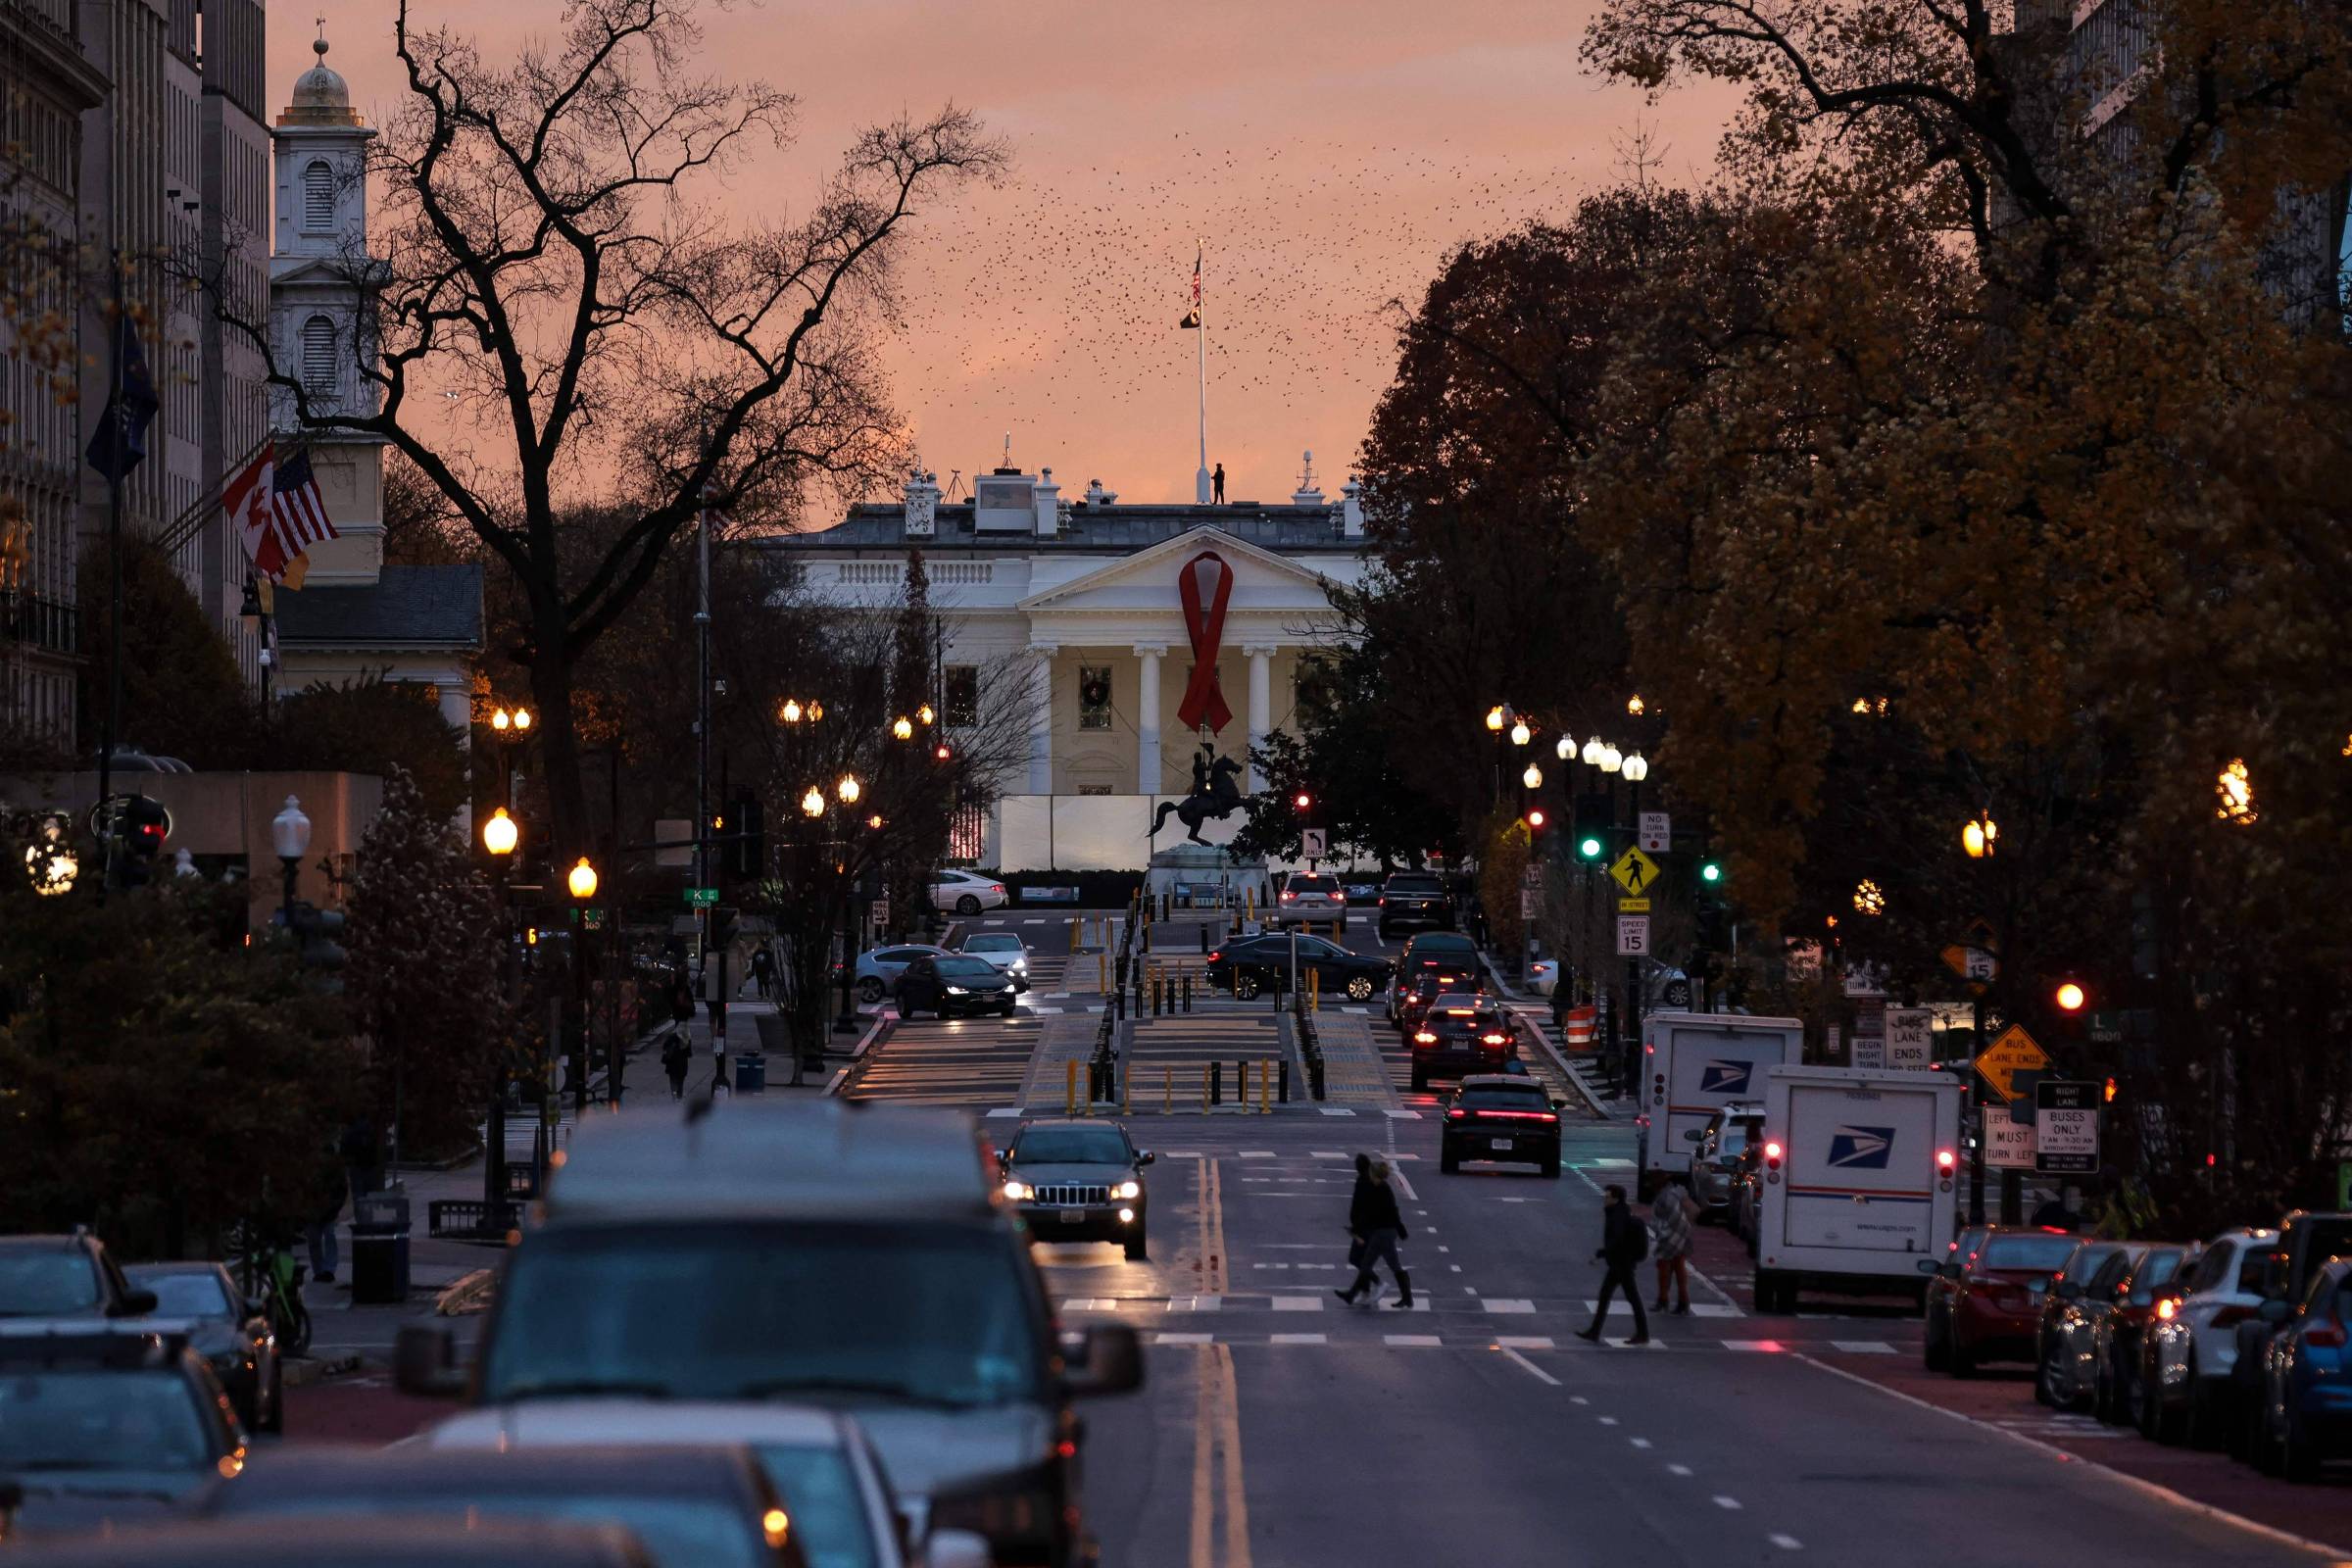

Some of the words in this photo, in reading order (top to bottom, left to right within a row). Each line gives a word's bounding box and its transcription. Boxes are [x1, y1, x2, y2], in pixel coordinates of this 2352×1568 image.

[1648, 814, 1662, 823] NO
[694, 890, 703, 901] K
[1624, 936, 1642, 951] 15
[1970, 964, 1990, 979] 15
[2094, 1013, 2105, 1028] L
[1894, 1032, 1922, 1044] LANE
[2006, 1040, 2027, 1049] BUS
[1857, 1051, 1882, 1059] RIGHT
[1894, 1049, 1923, 1059] ENDS
[1990, 1054, 2012, 1062] LANE
[2017, 1054, 2040, 1063] ENDS
[2056, 1087, 2080, 1097] RIGHT
[2057, 1098, 2079, 1106] LANE
[1988, 1114, 2009, 1124] LEFT
[2050, 1112, 2085, 1122] BUSES
[2053, 1124, 2082, 1135] ONLY
[1997, 1132, 2030, 1144] MUST
[1986, 1149, 2010, 1159] TURN
